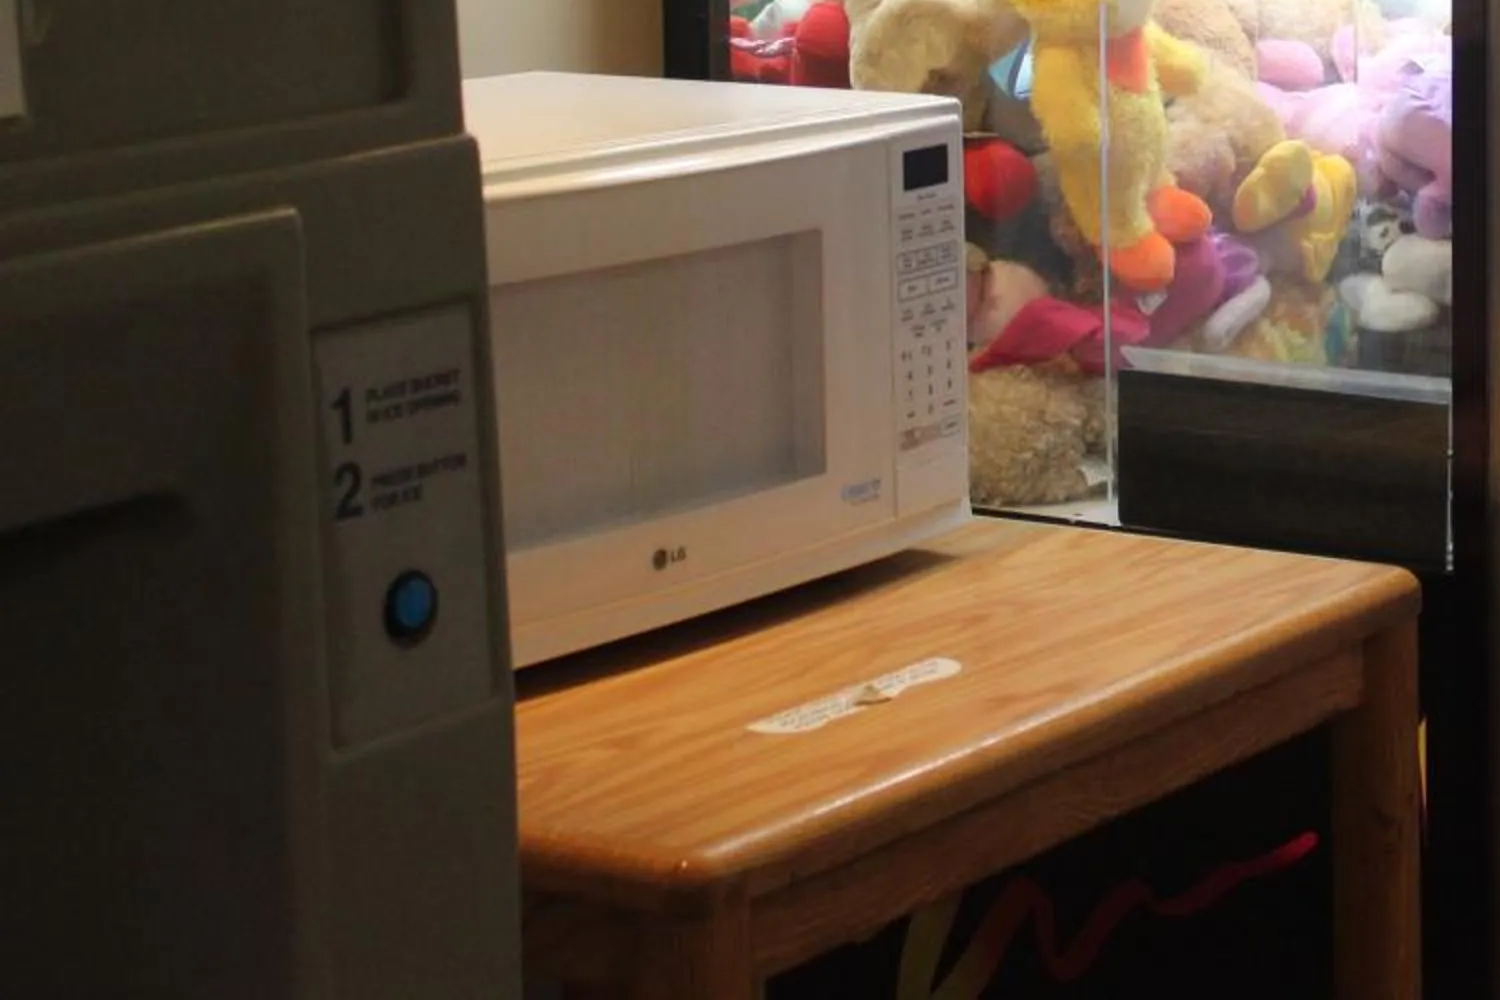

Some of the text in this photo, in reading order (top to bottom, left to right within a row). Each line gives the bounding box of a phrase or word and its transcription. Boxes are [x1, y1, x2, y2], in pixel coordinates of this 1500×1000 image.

[331, 385, 353, 445] 1
[333, 461, 364, 522] 2
[670, 546, 687, 563] LG
